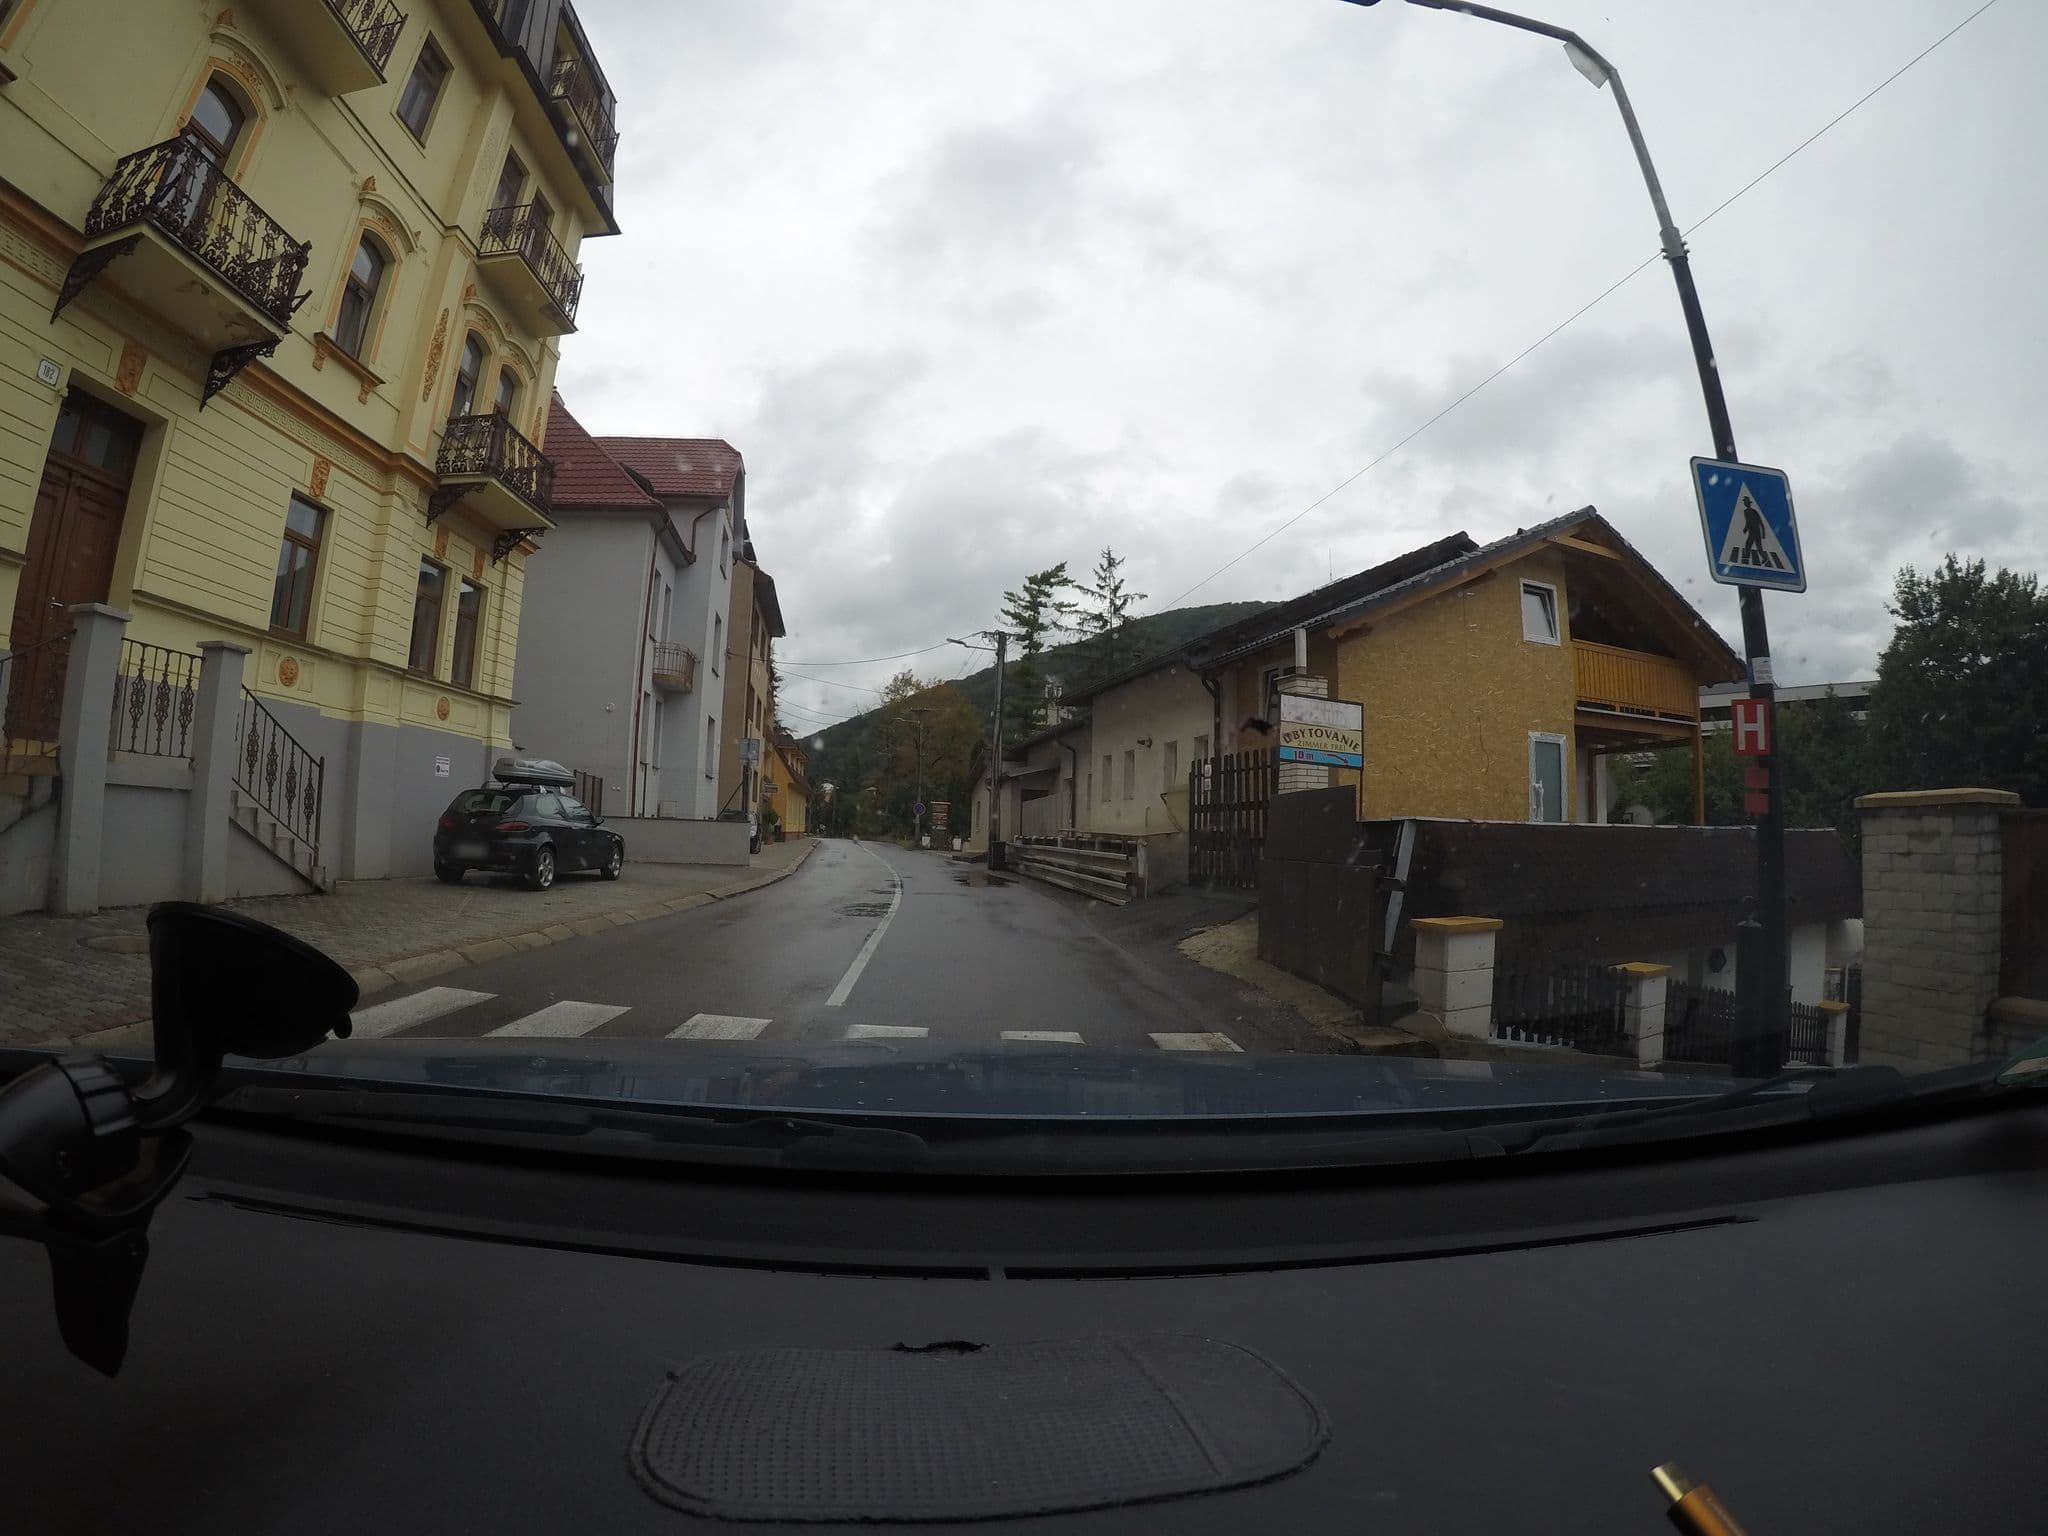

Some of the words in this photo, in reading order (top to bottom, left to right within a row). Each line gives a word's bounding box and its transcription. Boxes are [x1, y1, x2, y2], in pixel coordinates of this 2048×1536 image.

[1736, 704, 1766, 750] H
[1282, 728, 1361, 752] UBYTOVANIE
[1297, 740, 1329, 750] ZIMMER
[1331, 743, 1346, 752] FREI
[1293, 750, 1304, 760] 10
